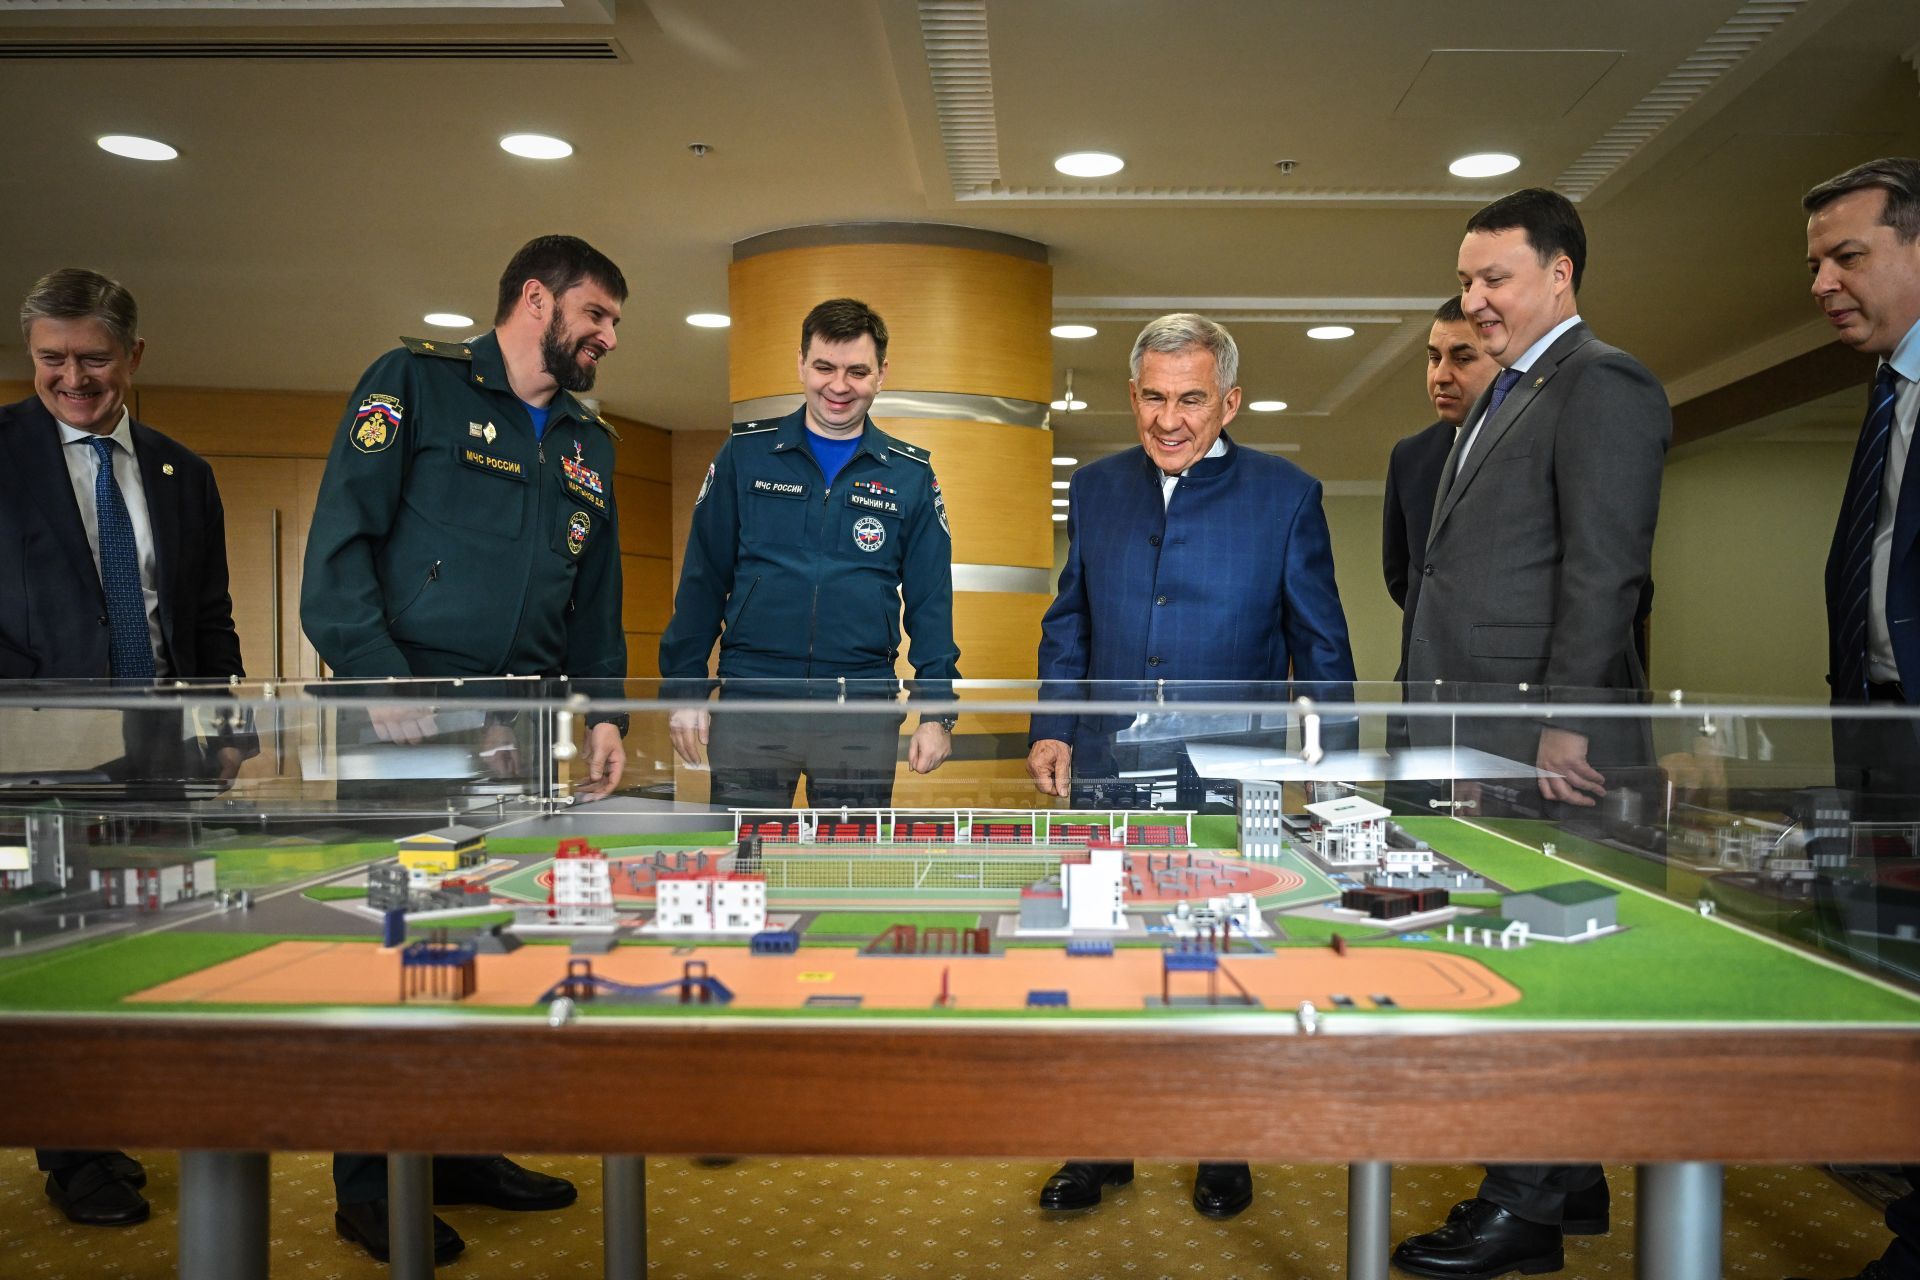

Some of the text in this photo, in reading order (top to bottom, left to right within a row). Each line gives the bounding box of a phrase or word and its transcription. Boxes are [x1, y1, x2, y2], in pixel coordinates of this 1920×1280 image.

[466, 450, 521, 474] МЧС РОССИИ
[754, 480, 803, 493] МЧС РОССИИ
[851, 494, 898, 511] КУРЫНИН Р.В.
